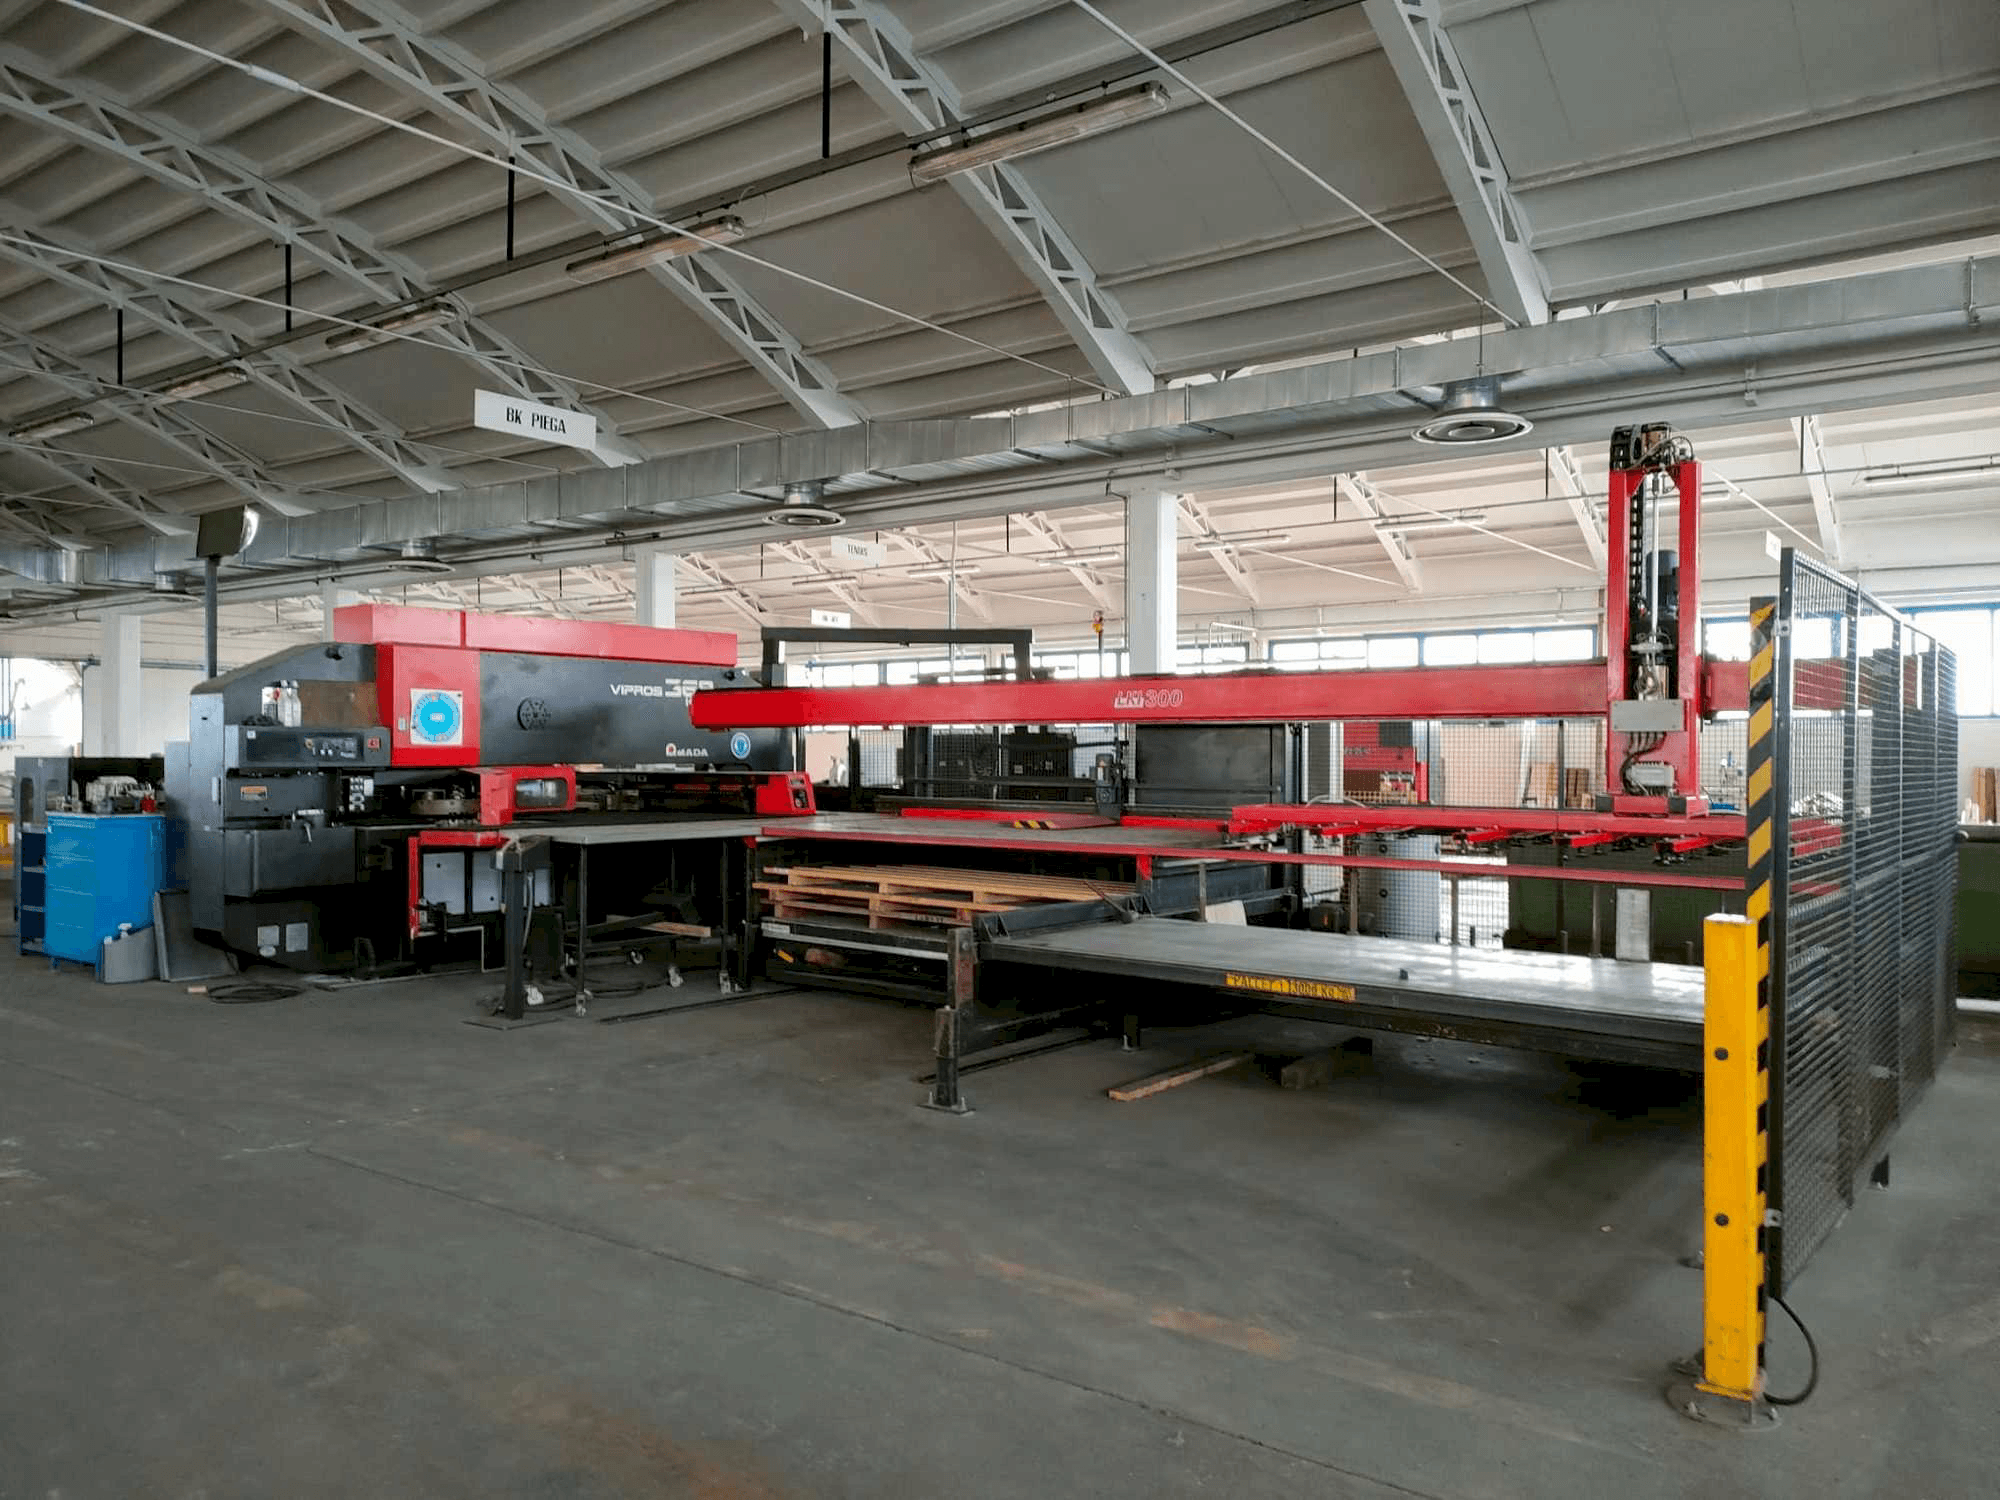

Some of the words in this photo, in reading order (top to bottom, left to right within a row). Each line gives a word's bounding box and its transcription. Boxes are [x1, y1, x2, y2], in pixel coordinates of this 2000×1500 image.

[506, 407, 522, 425] BK
[531, 413, 566, 434] PIEGA
[609, 684, 663, 698] VIPROS
[666, 742, 709, 757] AMADA
